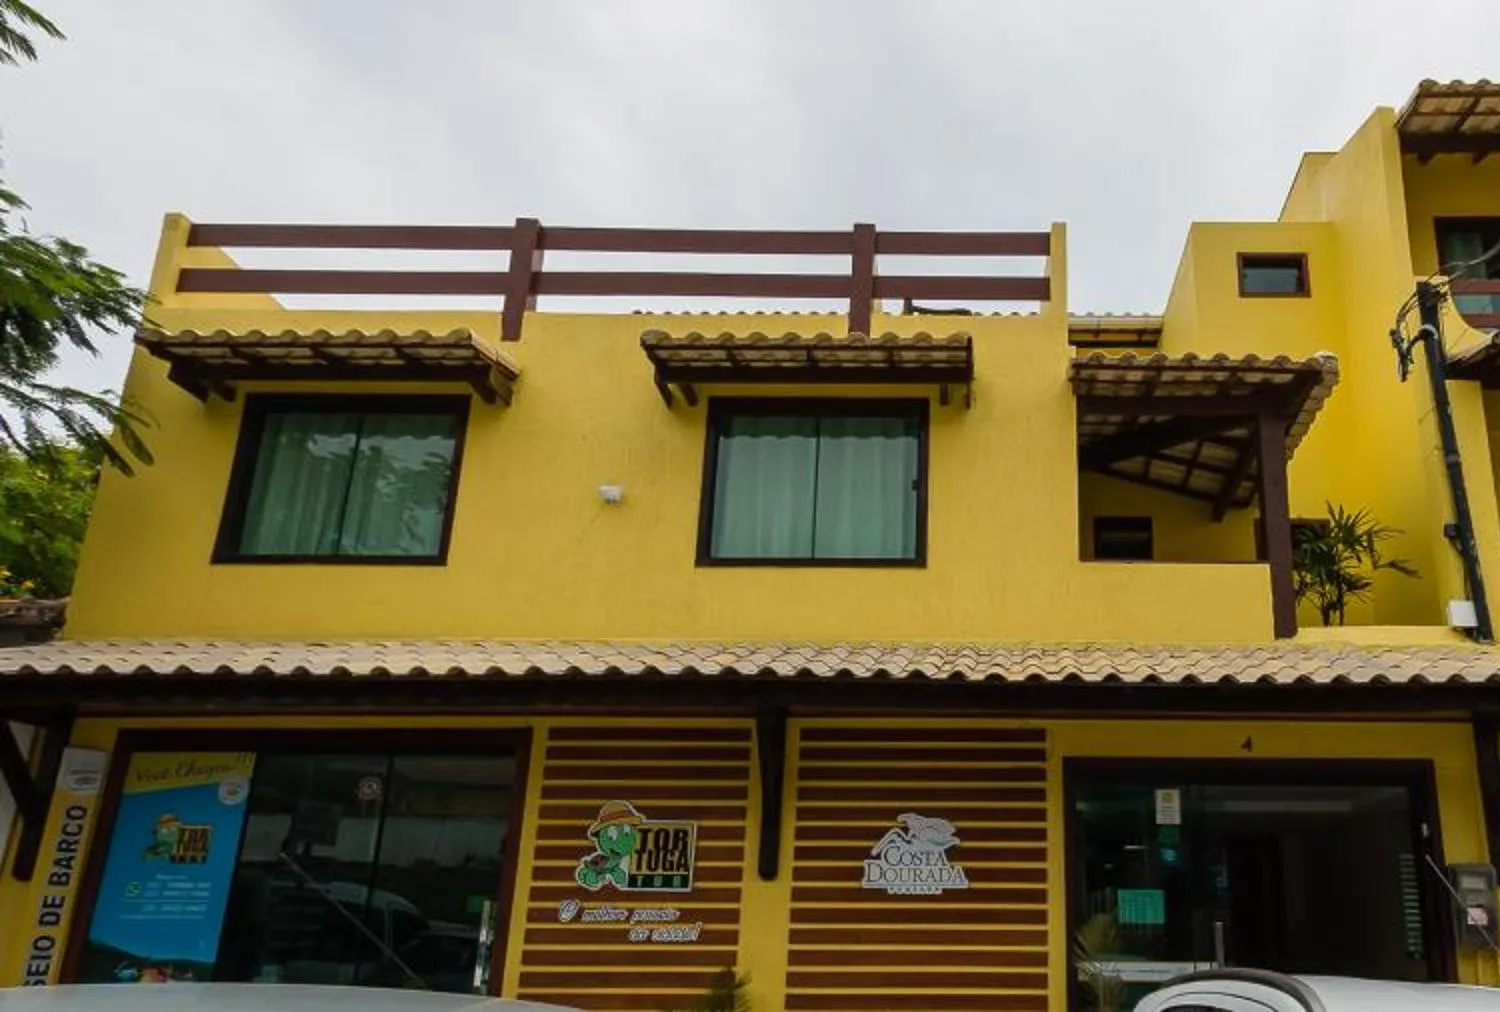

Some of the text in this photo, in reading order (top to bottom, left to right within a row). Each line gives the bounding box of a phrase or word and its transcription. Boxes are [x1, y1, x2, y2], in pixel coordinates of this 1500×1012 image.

[1240, 735, 1252, 753] 4
[48, 804, 87, 887] BARCO
[637, 828, 689, 852] TOR
[633, 850, 689, 872] TUGA
[883, 846, 948, 866] COSTA
[866, 863, 965, 883] DOURADA
[38, 895, 65, 926] DE
